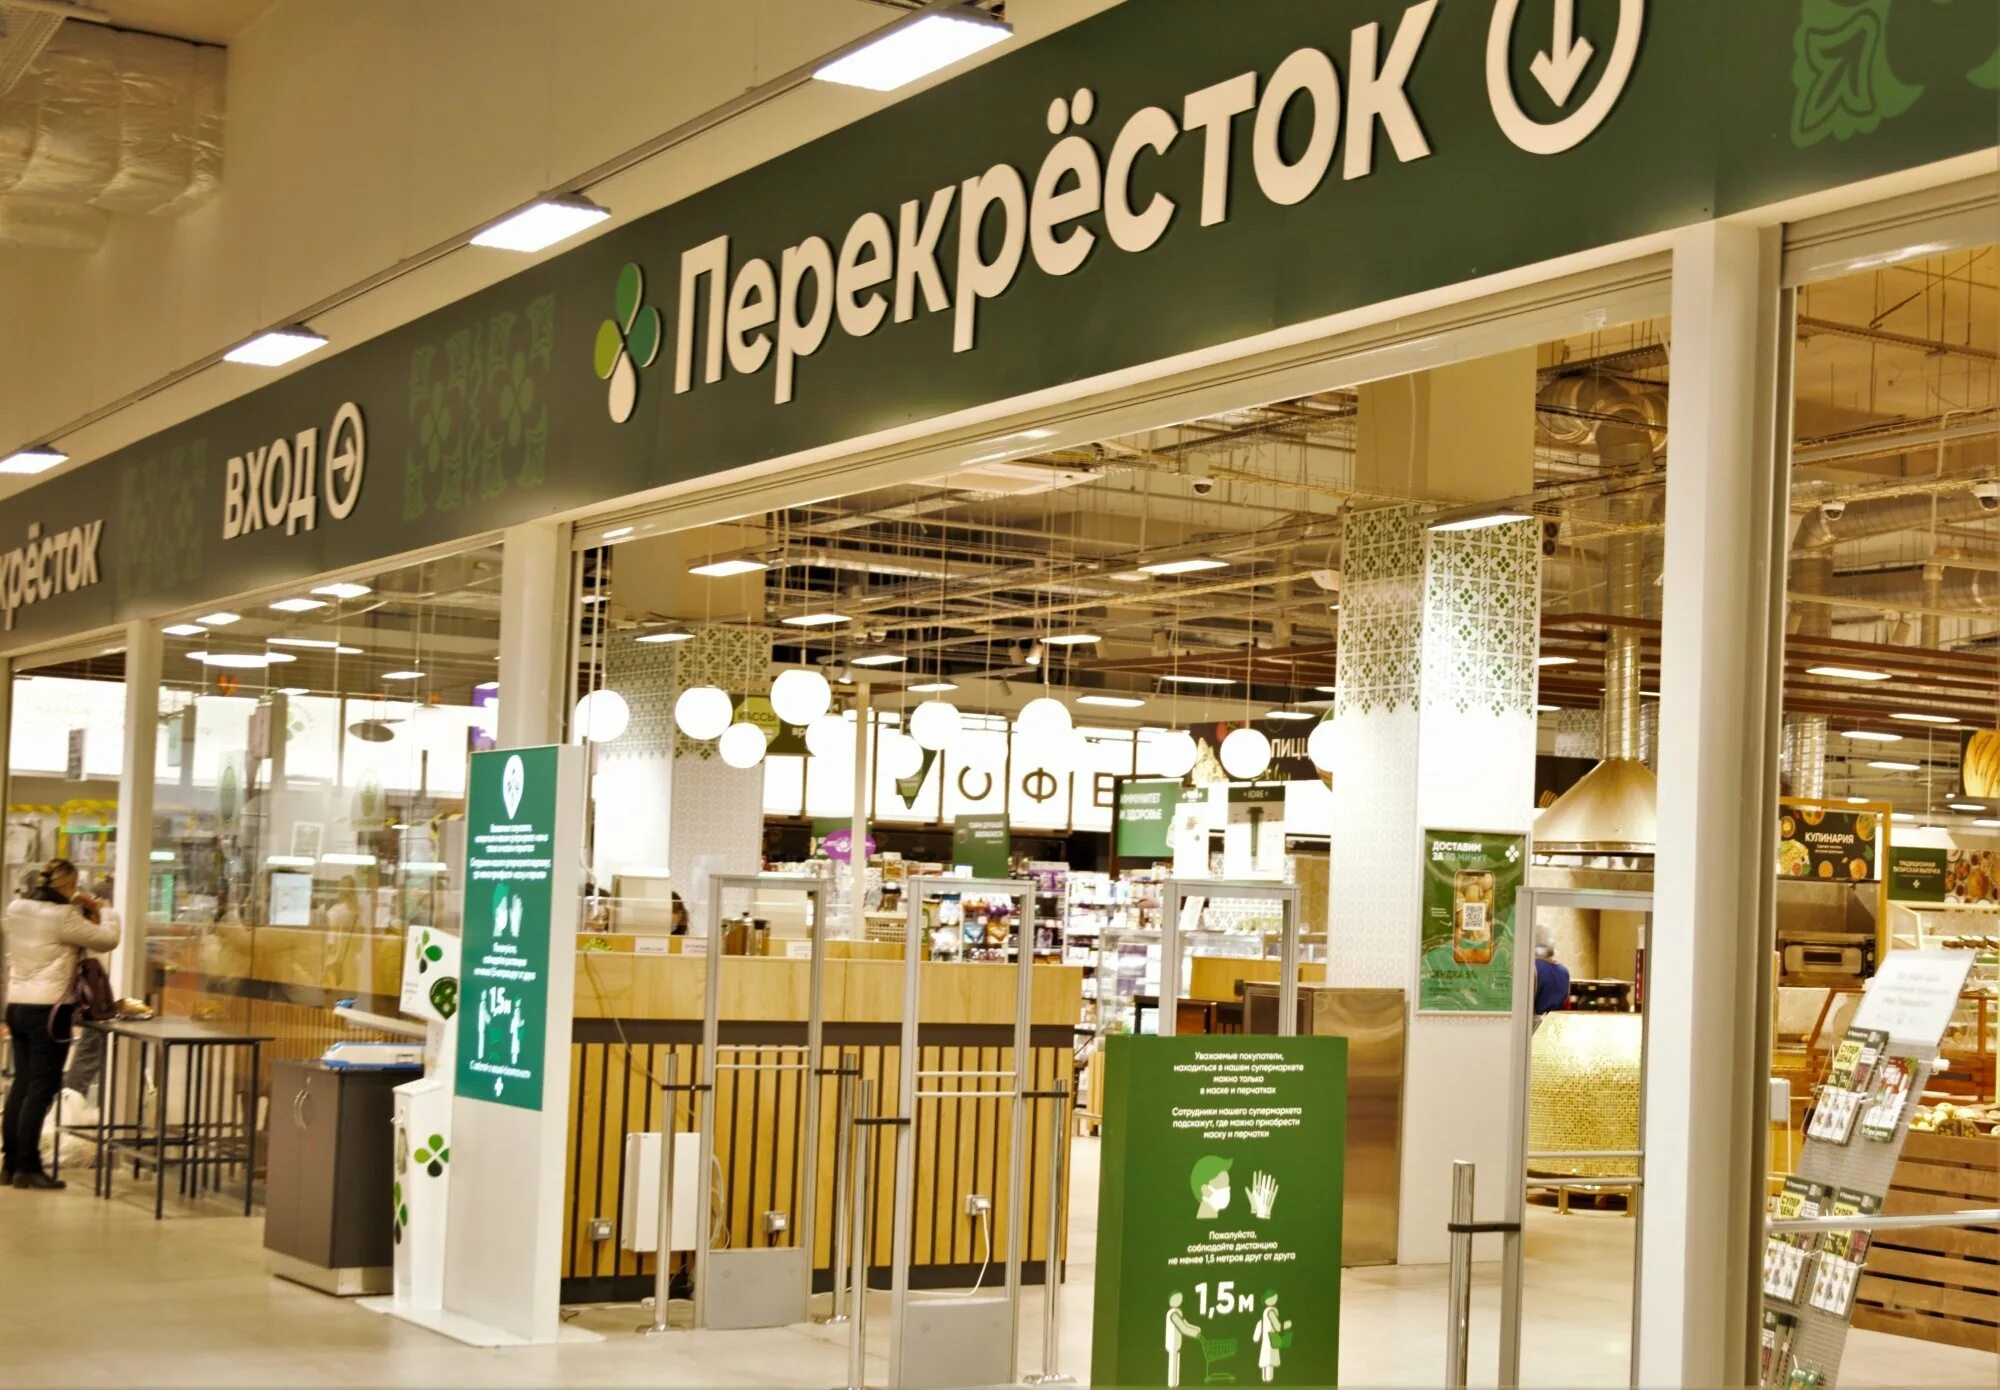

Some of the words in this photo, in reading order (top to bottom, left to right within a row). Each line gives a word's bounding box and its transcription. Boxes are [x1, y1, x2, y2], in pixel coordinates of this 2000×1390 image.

[674, 0, 1438, 405] Перекрёсток
[223, 427, 317, 540] ВХОД
[1804, 832, 1855, 845] КУЛИНАРИЯ
[1432, 841, 1482, 853] ДОСТАВИМ
[1432, 851, 1444, 861] ЗА
[1194, 1051, 1238, 1061] Уважаемые
[1239, 1052, 1285, 1062] покупатели,
[1173, 1064, 1217, 1073] находиться
[1224, 1064, 1250, 1072] нашем
[1251, 1063, 1304, 1073] супермаркете
[1213, 1075, 1238, 1083] можно
[1239, 1075, 1264, 1083] только
[1206, 1086, 1229, 1095] маске
[1236, 1086, 1277, 1096] перчатках
[1172, 1106, 1217, 1118] Сотрудники
[1218, 1108, 1248, 1116] нашего
[1248, 1107, 1302, 1117] супермаркета
[1172, 1119, 1215, 1129] подскажут,
[1216, 1119, 1228, 1129] где
[1229, 1118, 1255, 1127] можно
[1255, 1117, 1301, 1127] приобрести
[1203, 1131, 1227, 1140] маску
[1234, 1130, 1270, 1140] перчатки
[1208, 1230, 1257, 1241] Пожалуйста,
[1186, 1242, 1234, 1253] соблюдайте
[1234, 1241, 1278, 1252] дистанцию
[1168, 1257, 1179, 1265] не
[1179, 1255, 1204, 1265] менее
[1204, 1254, 1215, 1264] 1,5
[1215, 1254, 1244, 1264] метров
[1244, 1252, 1263, 1263] друг
[1263, 1253, 1272, 1261] от
[1273, 1251, 1297, 1262] друга
[1194, 1280, 1236, 1319] 1,5
[1237, 1293, 1256, 1313] м
